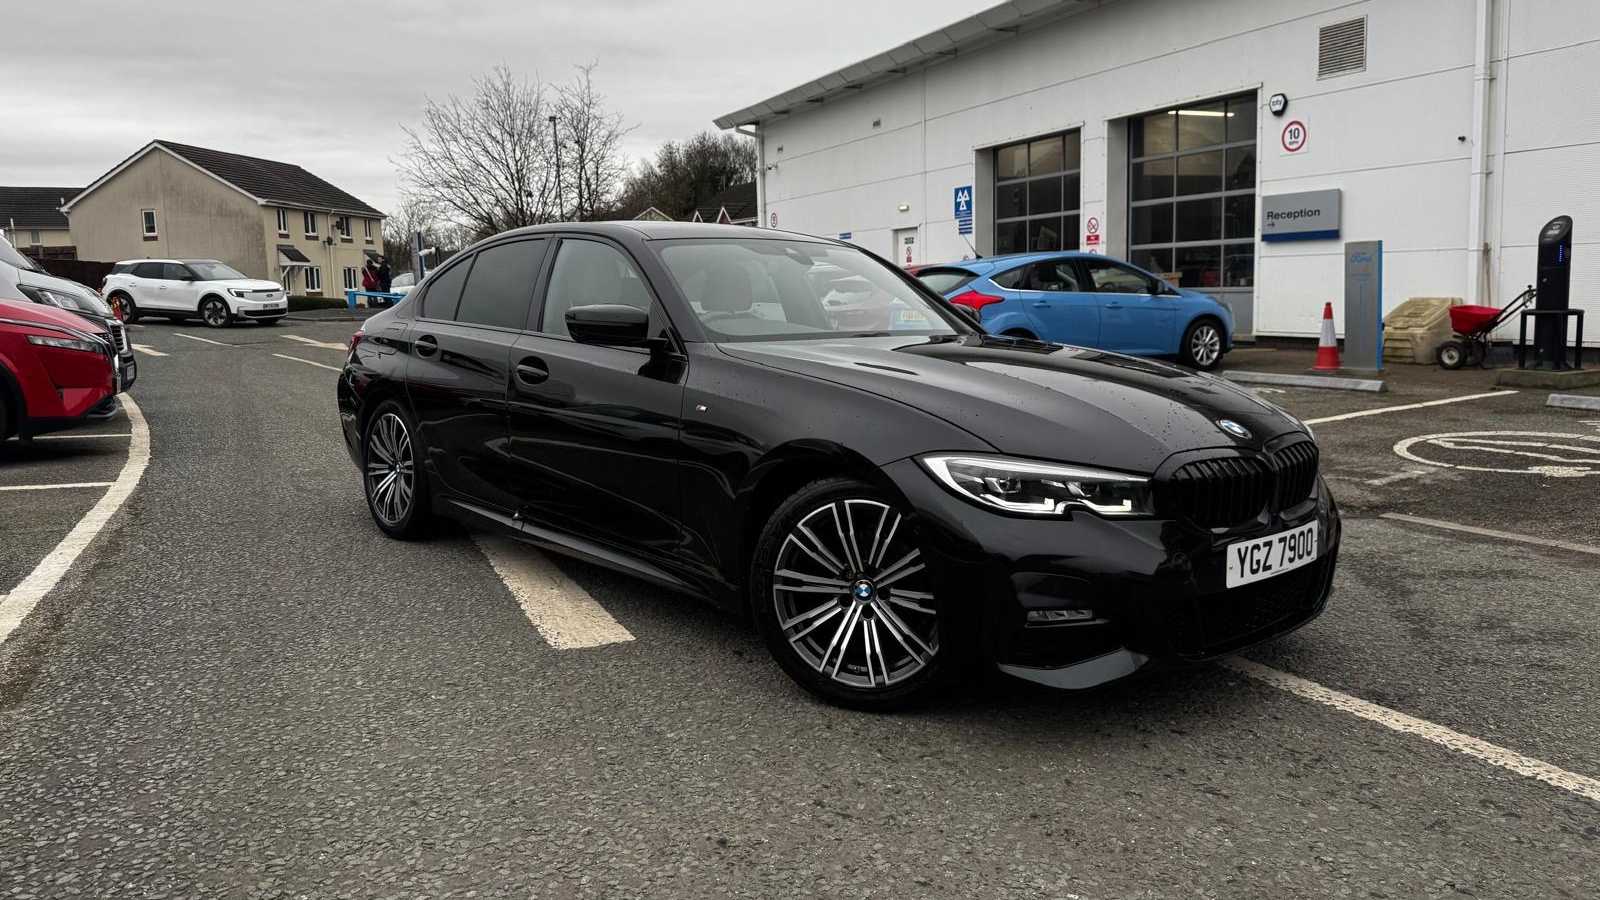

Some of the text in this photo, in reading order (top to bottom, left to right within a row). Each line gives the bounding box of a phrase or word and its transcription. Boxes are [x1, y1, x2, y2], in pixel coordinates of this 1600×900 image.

[1288, 127, 1300, 140] 10
[1266, 208, 1321, 220] Reception
[1237, 527, 1314, 578] YGZ 7900
